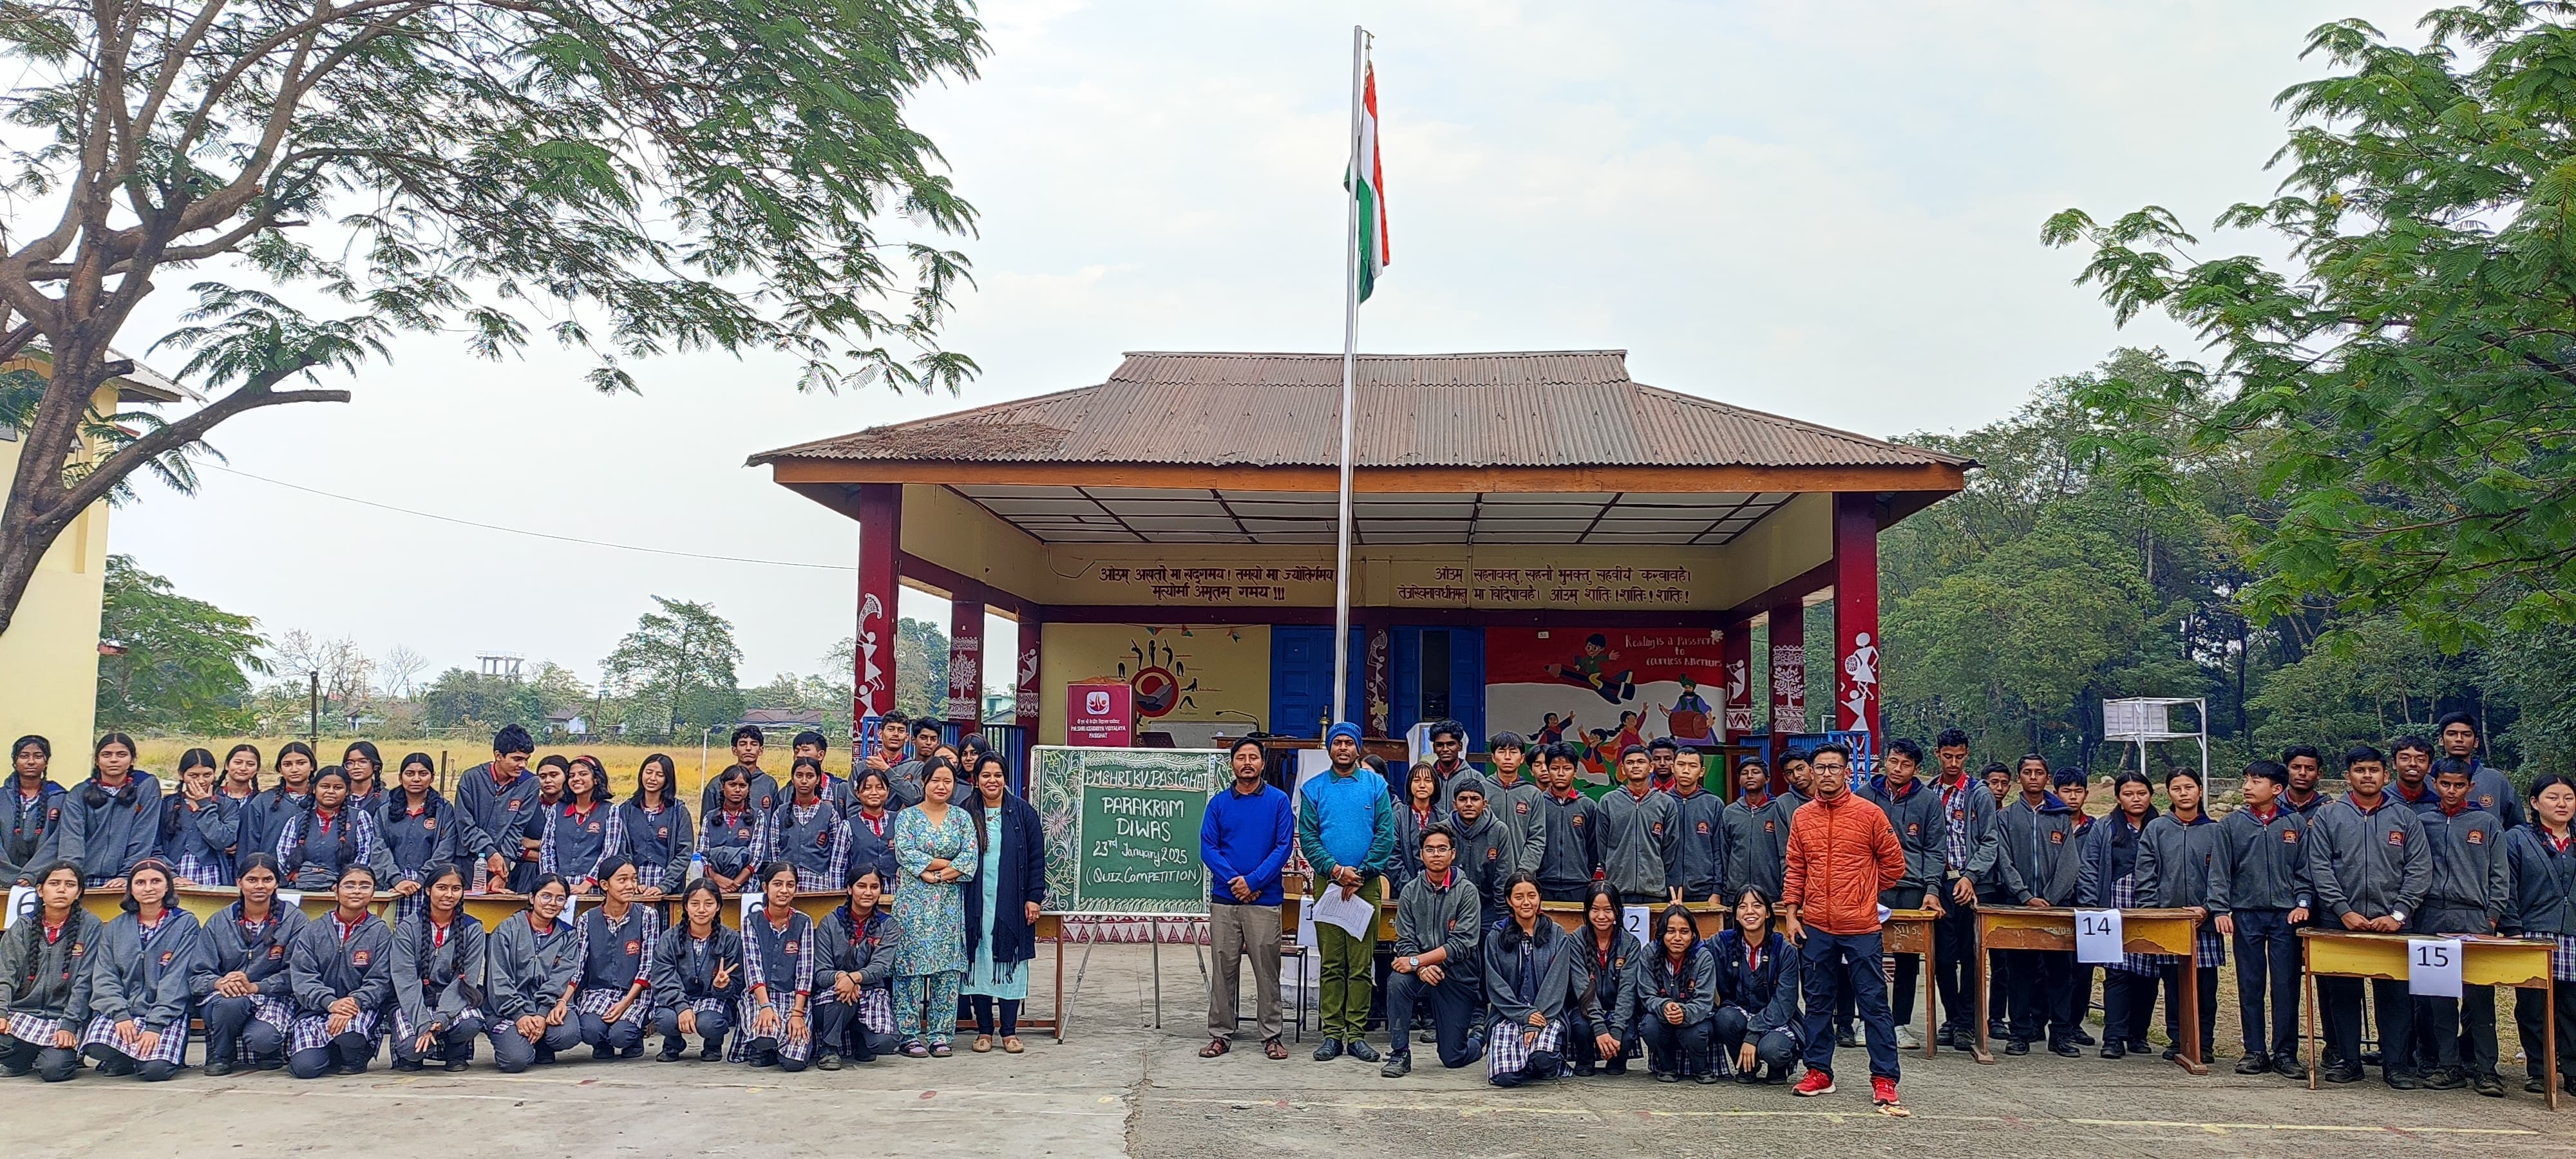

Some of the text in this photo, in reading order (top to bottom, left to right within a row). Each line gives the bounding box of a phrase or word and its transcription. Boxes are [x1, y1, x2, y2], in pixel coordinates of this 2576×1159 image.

[1133, 769, 1149, 787] KV
[1150, 769, 1208, 789] PASIGHAT
[1101, 796, 1184, 818] PARAKRAM
[1115, 817, 1171, 842] DIWAS
[1122, 842, 1160, 867] January
[1160, 847, 1188, 864] 2025
[1629, 915, 1640, 932] 2
[2082, 916, 2112, 936] 14
[2417, 946, 2449, 967] 15
